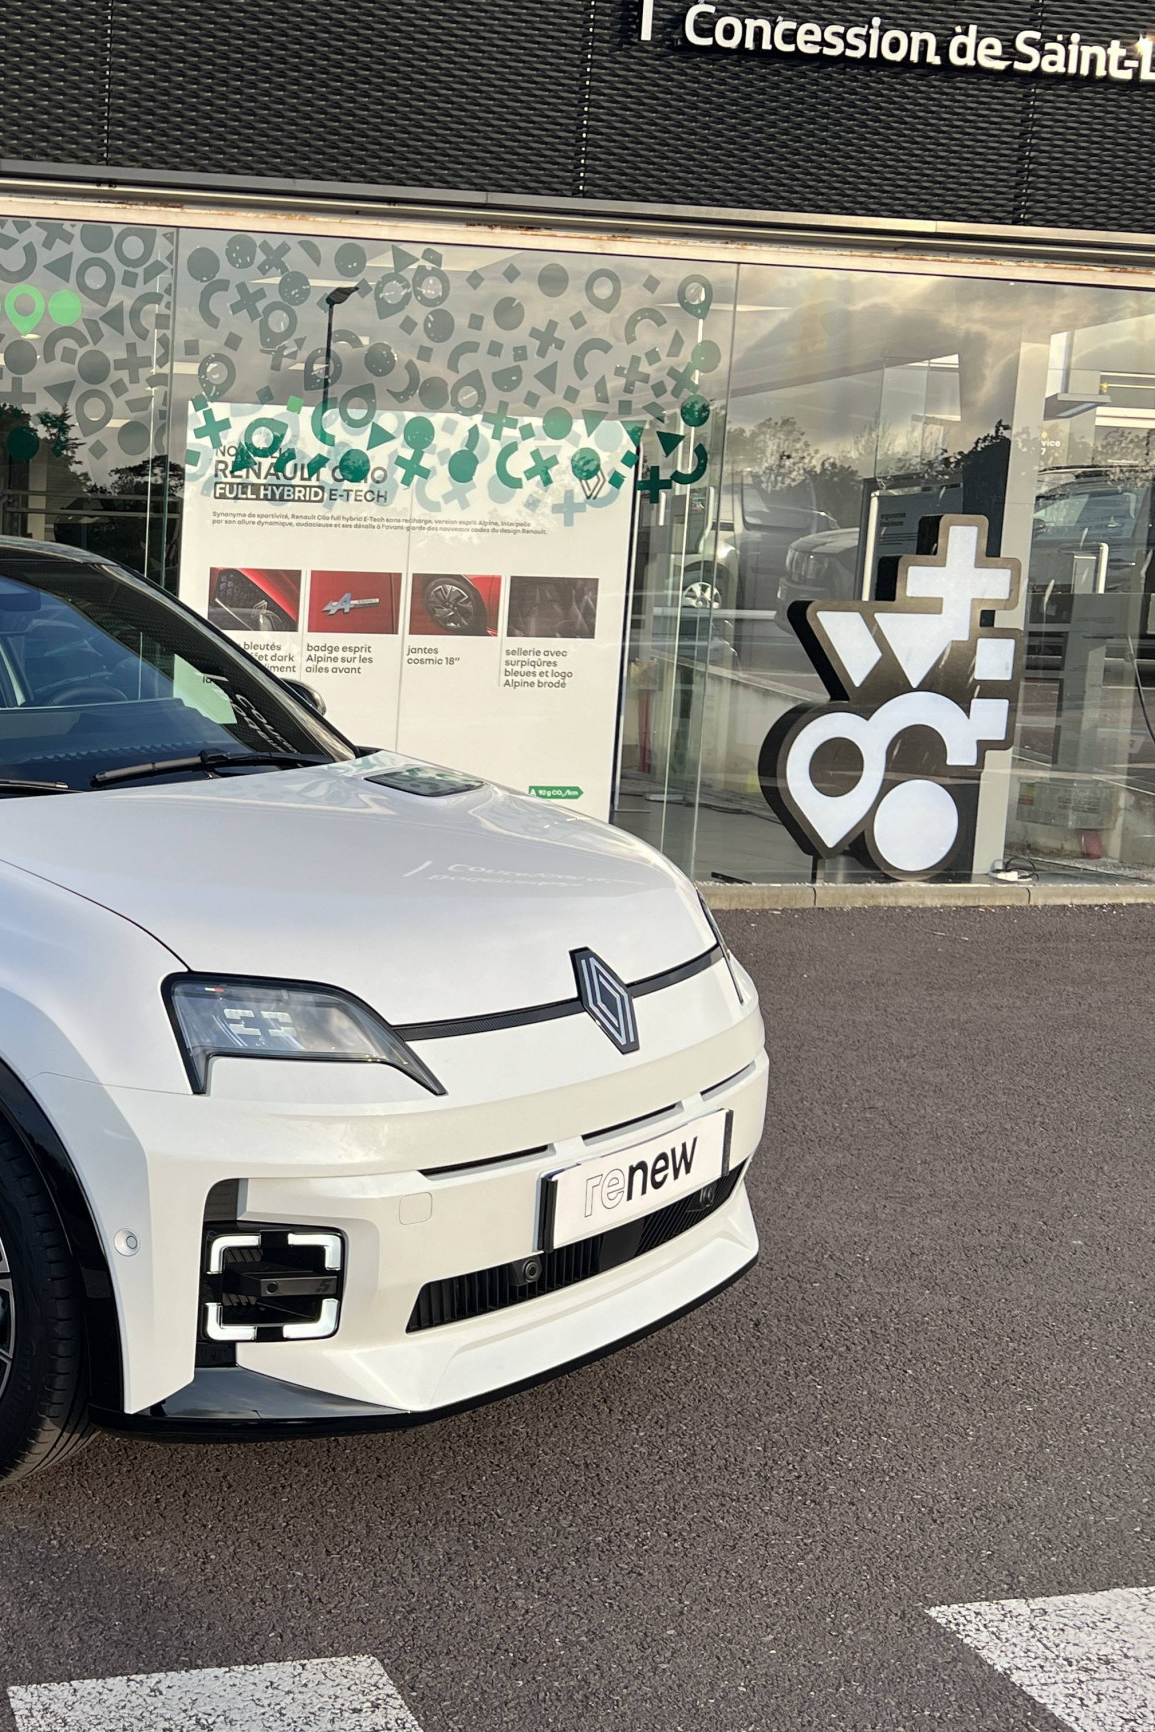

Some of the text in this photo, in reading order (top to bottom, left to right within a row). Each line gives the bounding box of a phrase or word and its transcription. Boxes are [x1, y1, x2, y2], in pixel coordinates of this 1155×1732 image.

[685, 3, 941, 65] Concession
[949, 25, 1010, 70] de
[215, 484, 387, 502] FULL HYBRID E-TECH
[243, 641, 281, 651] bleutés
[307, 643, 371, 655] badge esprit
[406, 645, 439, 656] jantes
[270, 653, 294, 662] dark
[505, 648, 567, 657] sellerie avec
[306, 654, 373, 664] Alpine sur les
[407, 656, 443, 665] cosmic
[504, 658, 558, 669] surpiqûres
[305, 664, 361, 674] ailes avant
[504, 668, 537, 677] bleues
[551, 669, 573, 680] logo
[503, 679, 566, 689] Alpine brodé
[584, 1135, 698, 1218] renew
